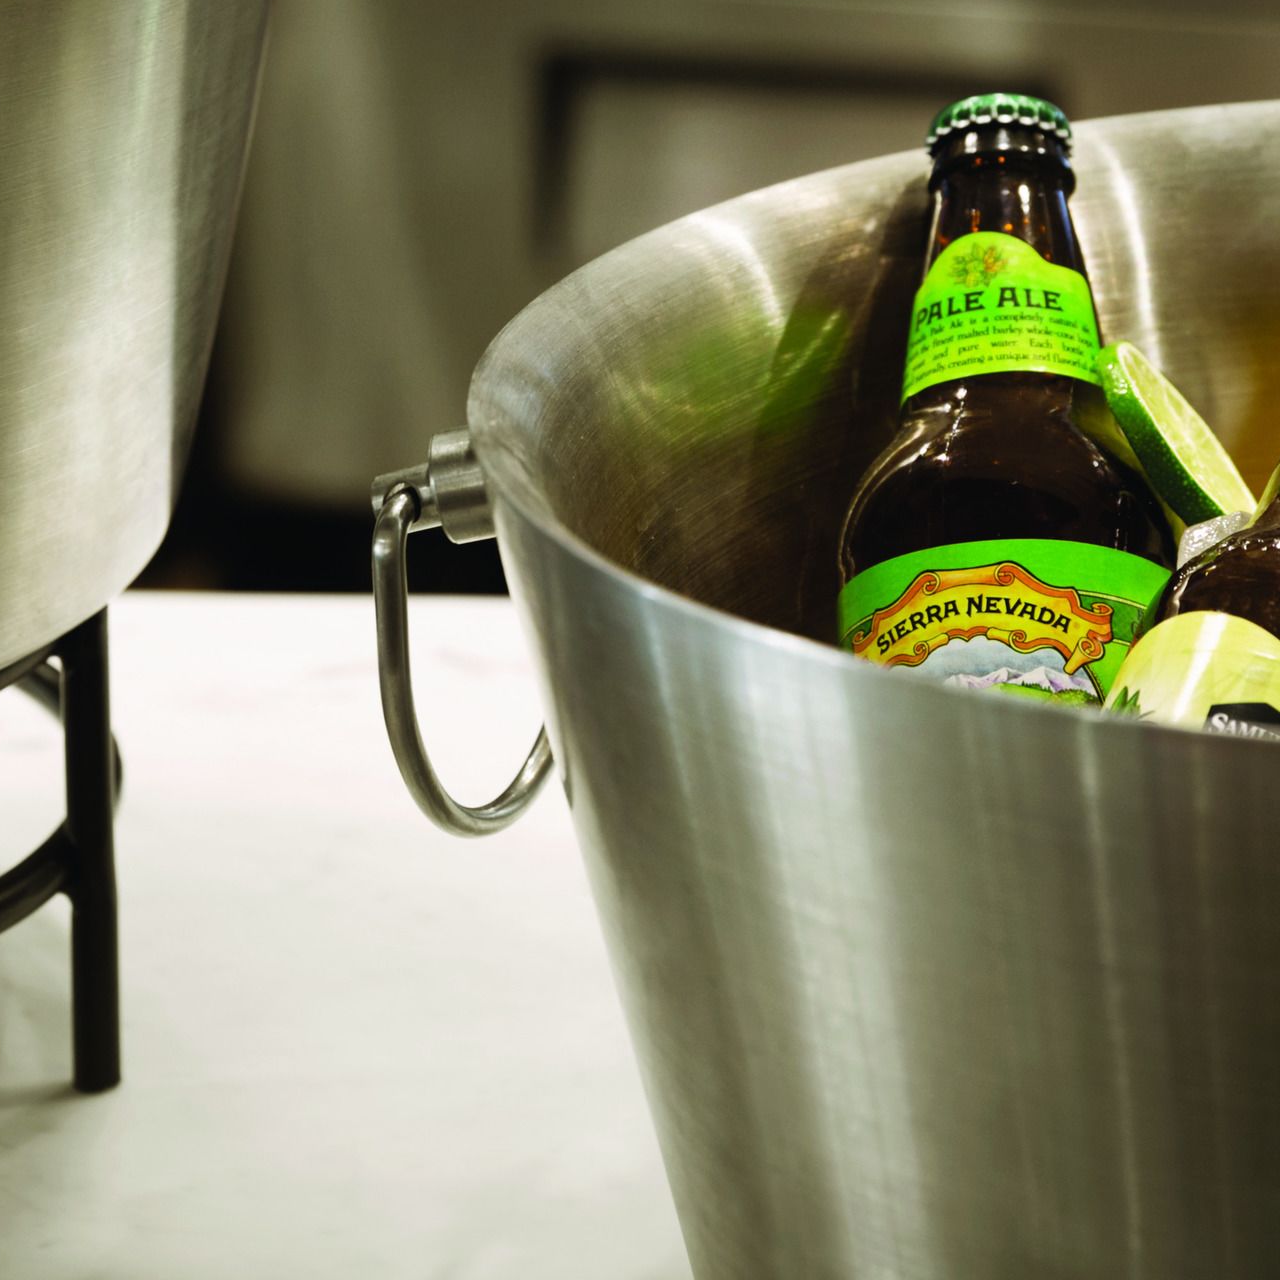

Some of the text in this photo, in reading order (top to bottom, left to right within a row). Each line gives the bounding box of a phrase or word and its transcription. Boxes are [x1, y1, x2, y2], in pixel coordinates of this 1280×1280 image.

[914, 286, 1064, 333] PALE ALE
[993, 311, 1043, 324] completely
[957, 326, 989, 340] malted
[958, 344, 980, 356] pure
[1029, 338, 1053, 350] Each
[947, 355, 984, 369] creating
[995, 351, 1029, 362] unique
[875, 593, 1073, 656] SIERRA NEVADA
